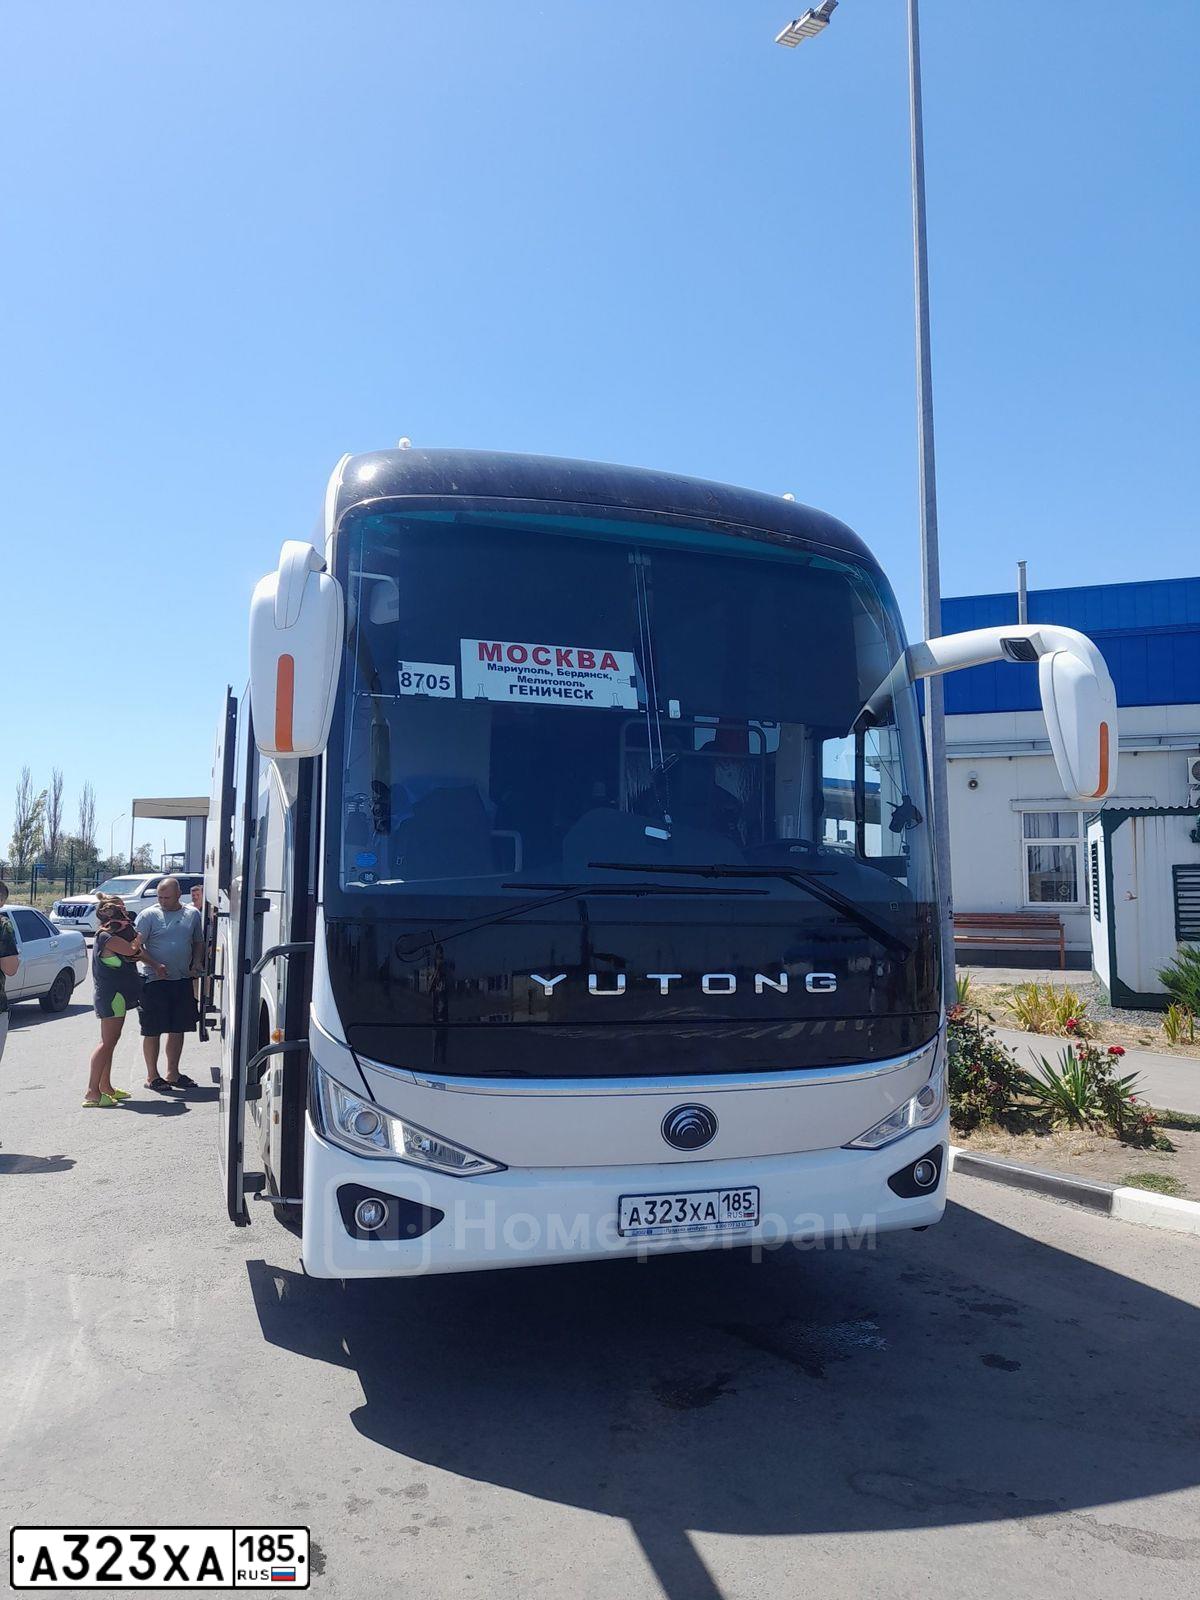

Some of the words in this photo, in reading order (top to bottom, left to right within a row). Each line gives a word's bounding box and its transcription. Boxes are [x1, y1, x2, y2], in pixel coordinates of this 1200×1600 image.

[478, 642, 620, 671] МОСКВА
[400, 671, 451, 691] 8705
[487, 663, 553, 676] Мариуполь,
[557, 668, 613, 681] Бердянск,
[517, 675, 586, 688] Мелитополь
[509, 684, 594, 700] ГЕНИЧЕСК
[530, 973, 837, 995] YUTONG
[629, 1198, 717, 1227] А323ХА
[722, 1192, 752, 1212] 185
[726, 1211, 743, 1219] RUS
